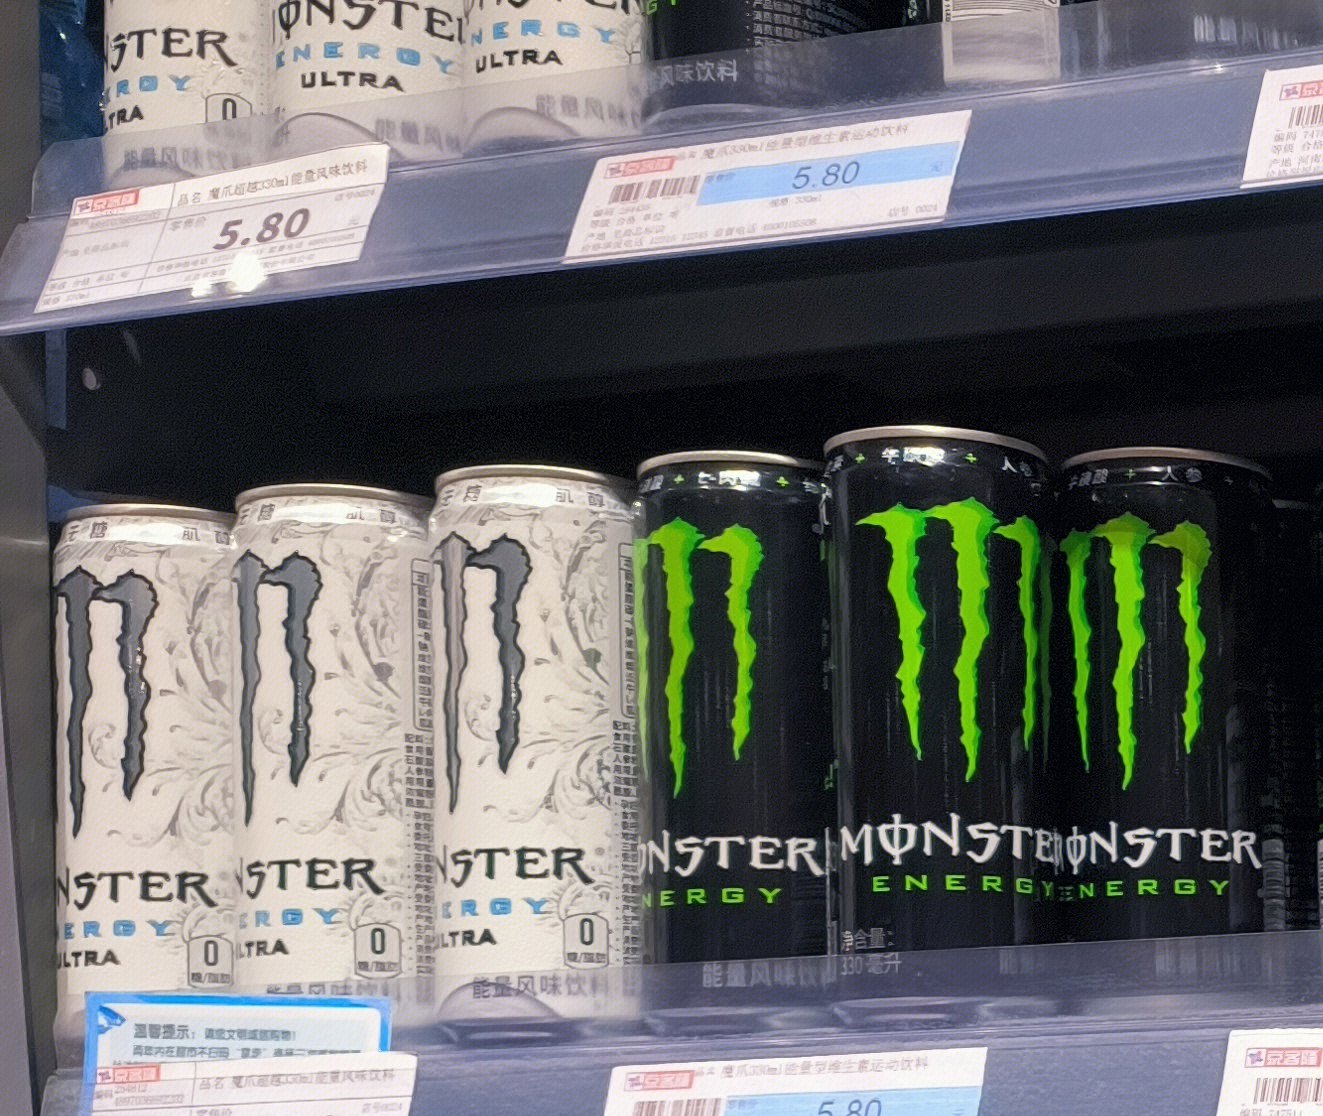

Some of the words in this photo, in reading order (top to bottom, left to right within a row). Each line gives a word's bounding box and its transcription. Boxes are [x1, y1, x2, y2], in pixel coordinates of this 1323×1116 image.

[475, 49, 562, 73] ULTRA
[301, 71, 405, 93] ULTRA
[791, 160, 862, 190] 5.80
[211, 206, 312, 251] 5.80
[872, 873, 1055, 898] ENERGY
